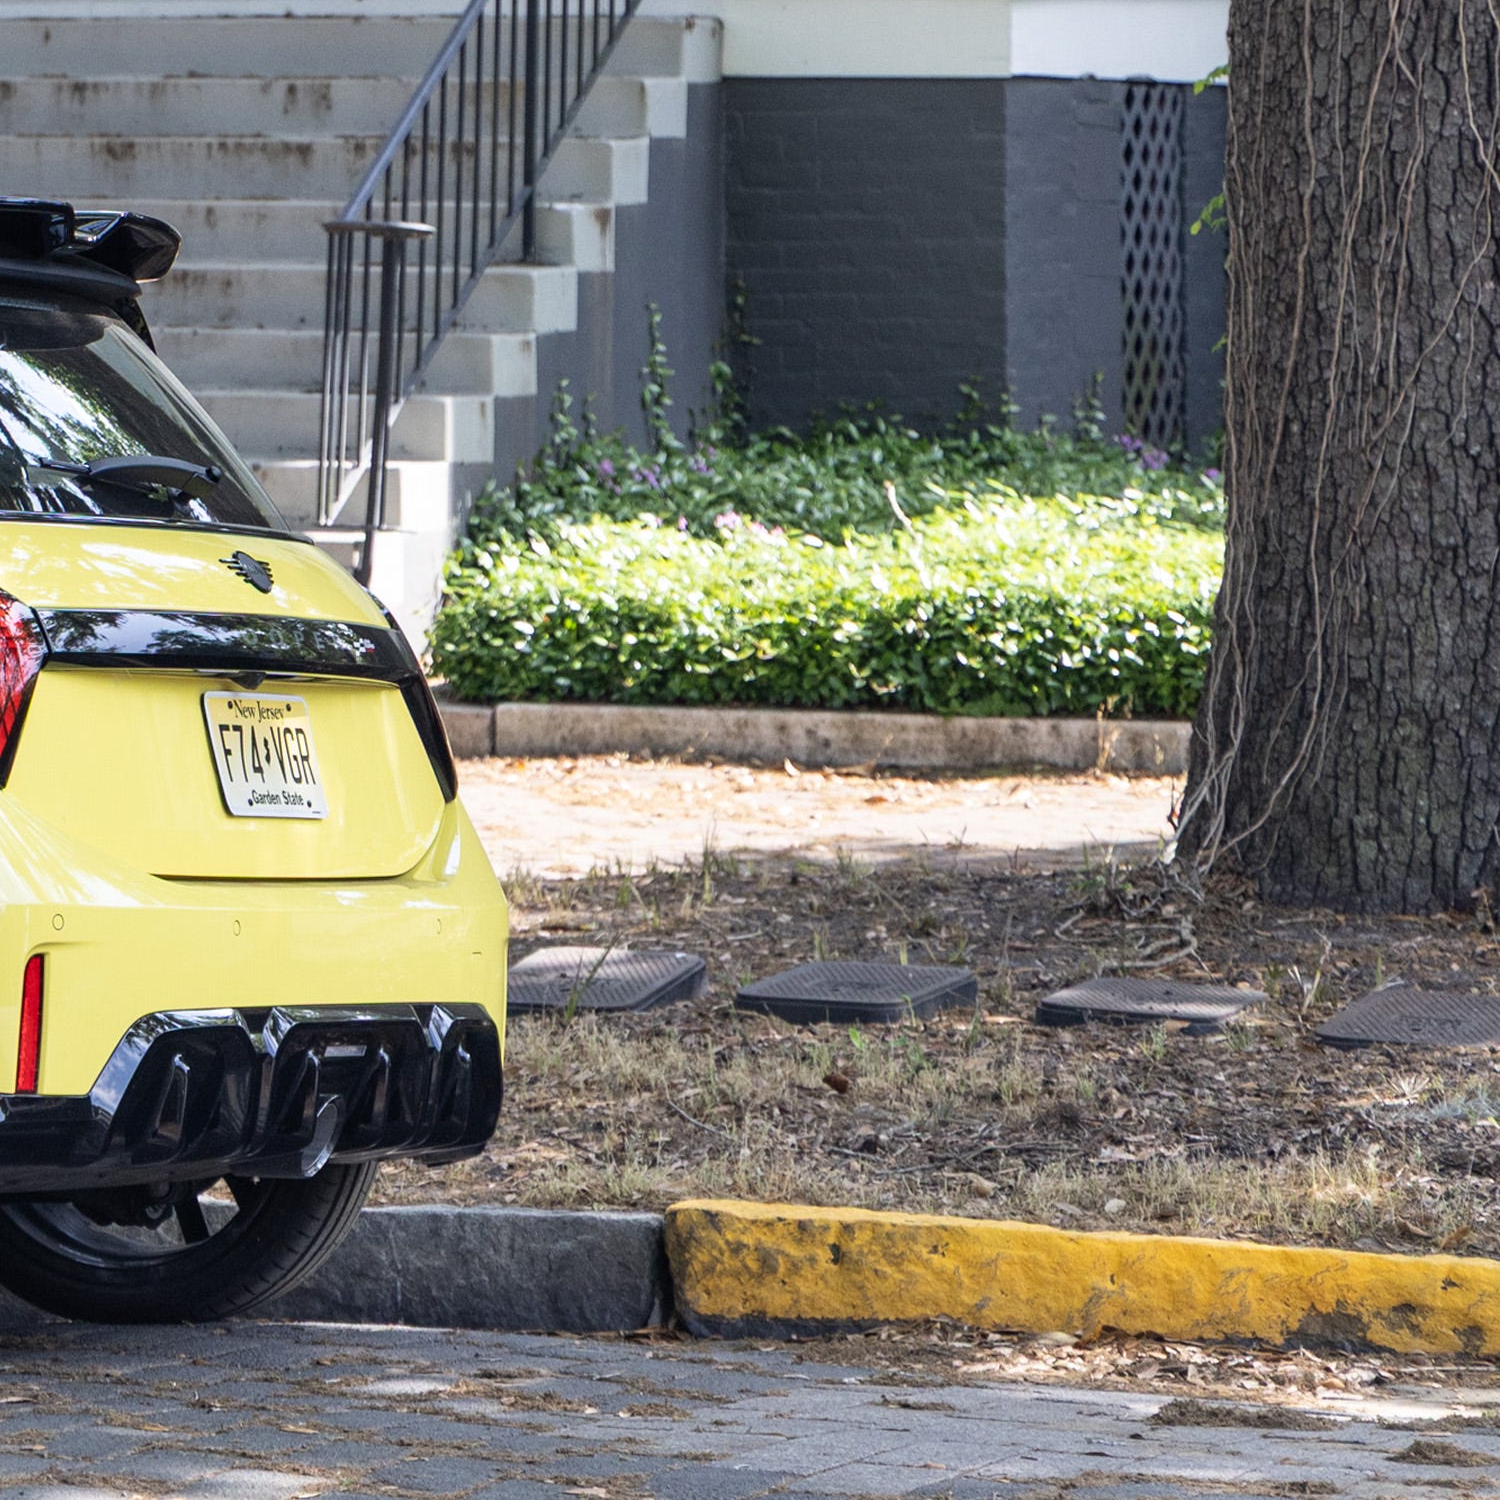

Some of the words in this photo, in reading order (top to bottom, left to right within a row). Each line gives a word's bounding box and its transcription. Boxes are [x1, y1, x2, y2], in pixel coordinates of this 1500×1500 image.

[233, 699, 256, 719] New
[256, 700, 284, 724] Jersey
[218, 724, 265, 783] F74
[269, 726, 316, 785] VGR
[251, 789, 282, 805] Garden
[281, 790, 304, 806] State
